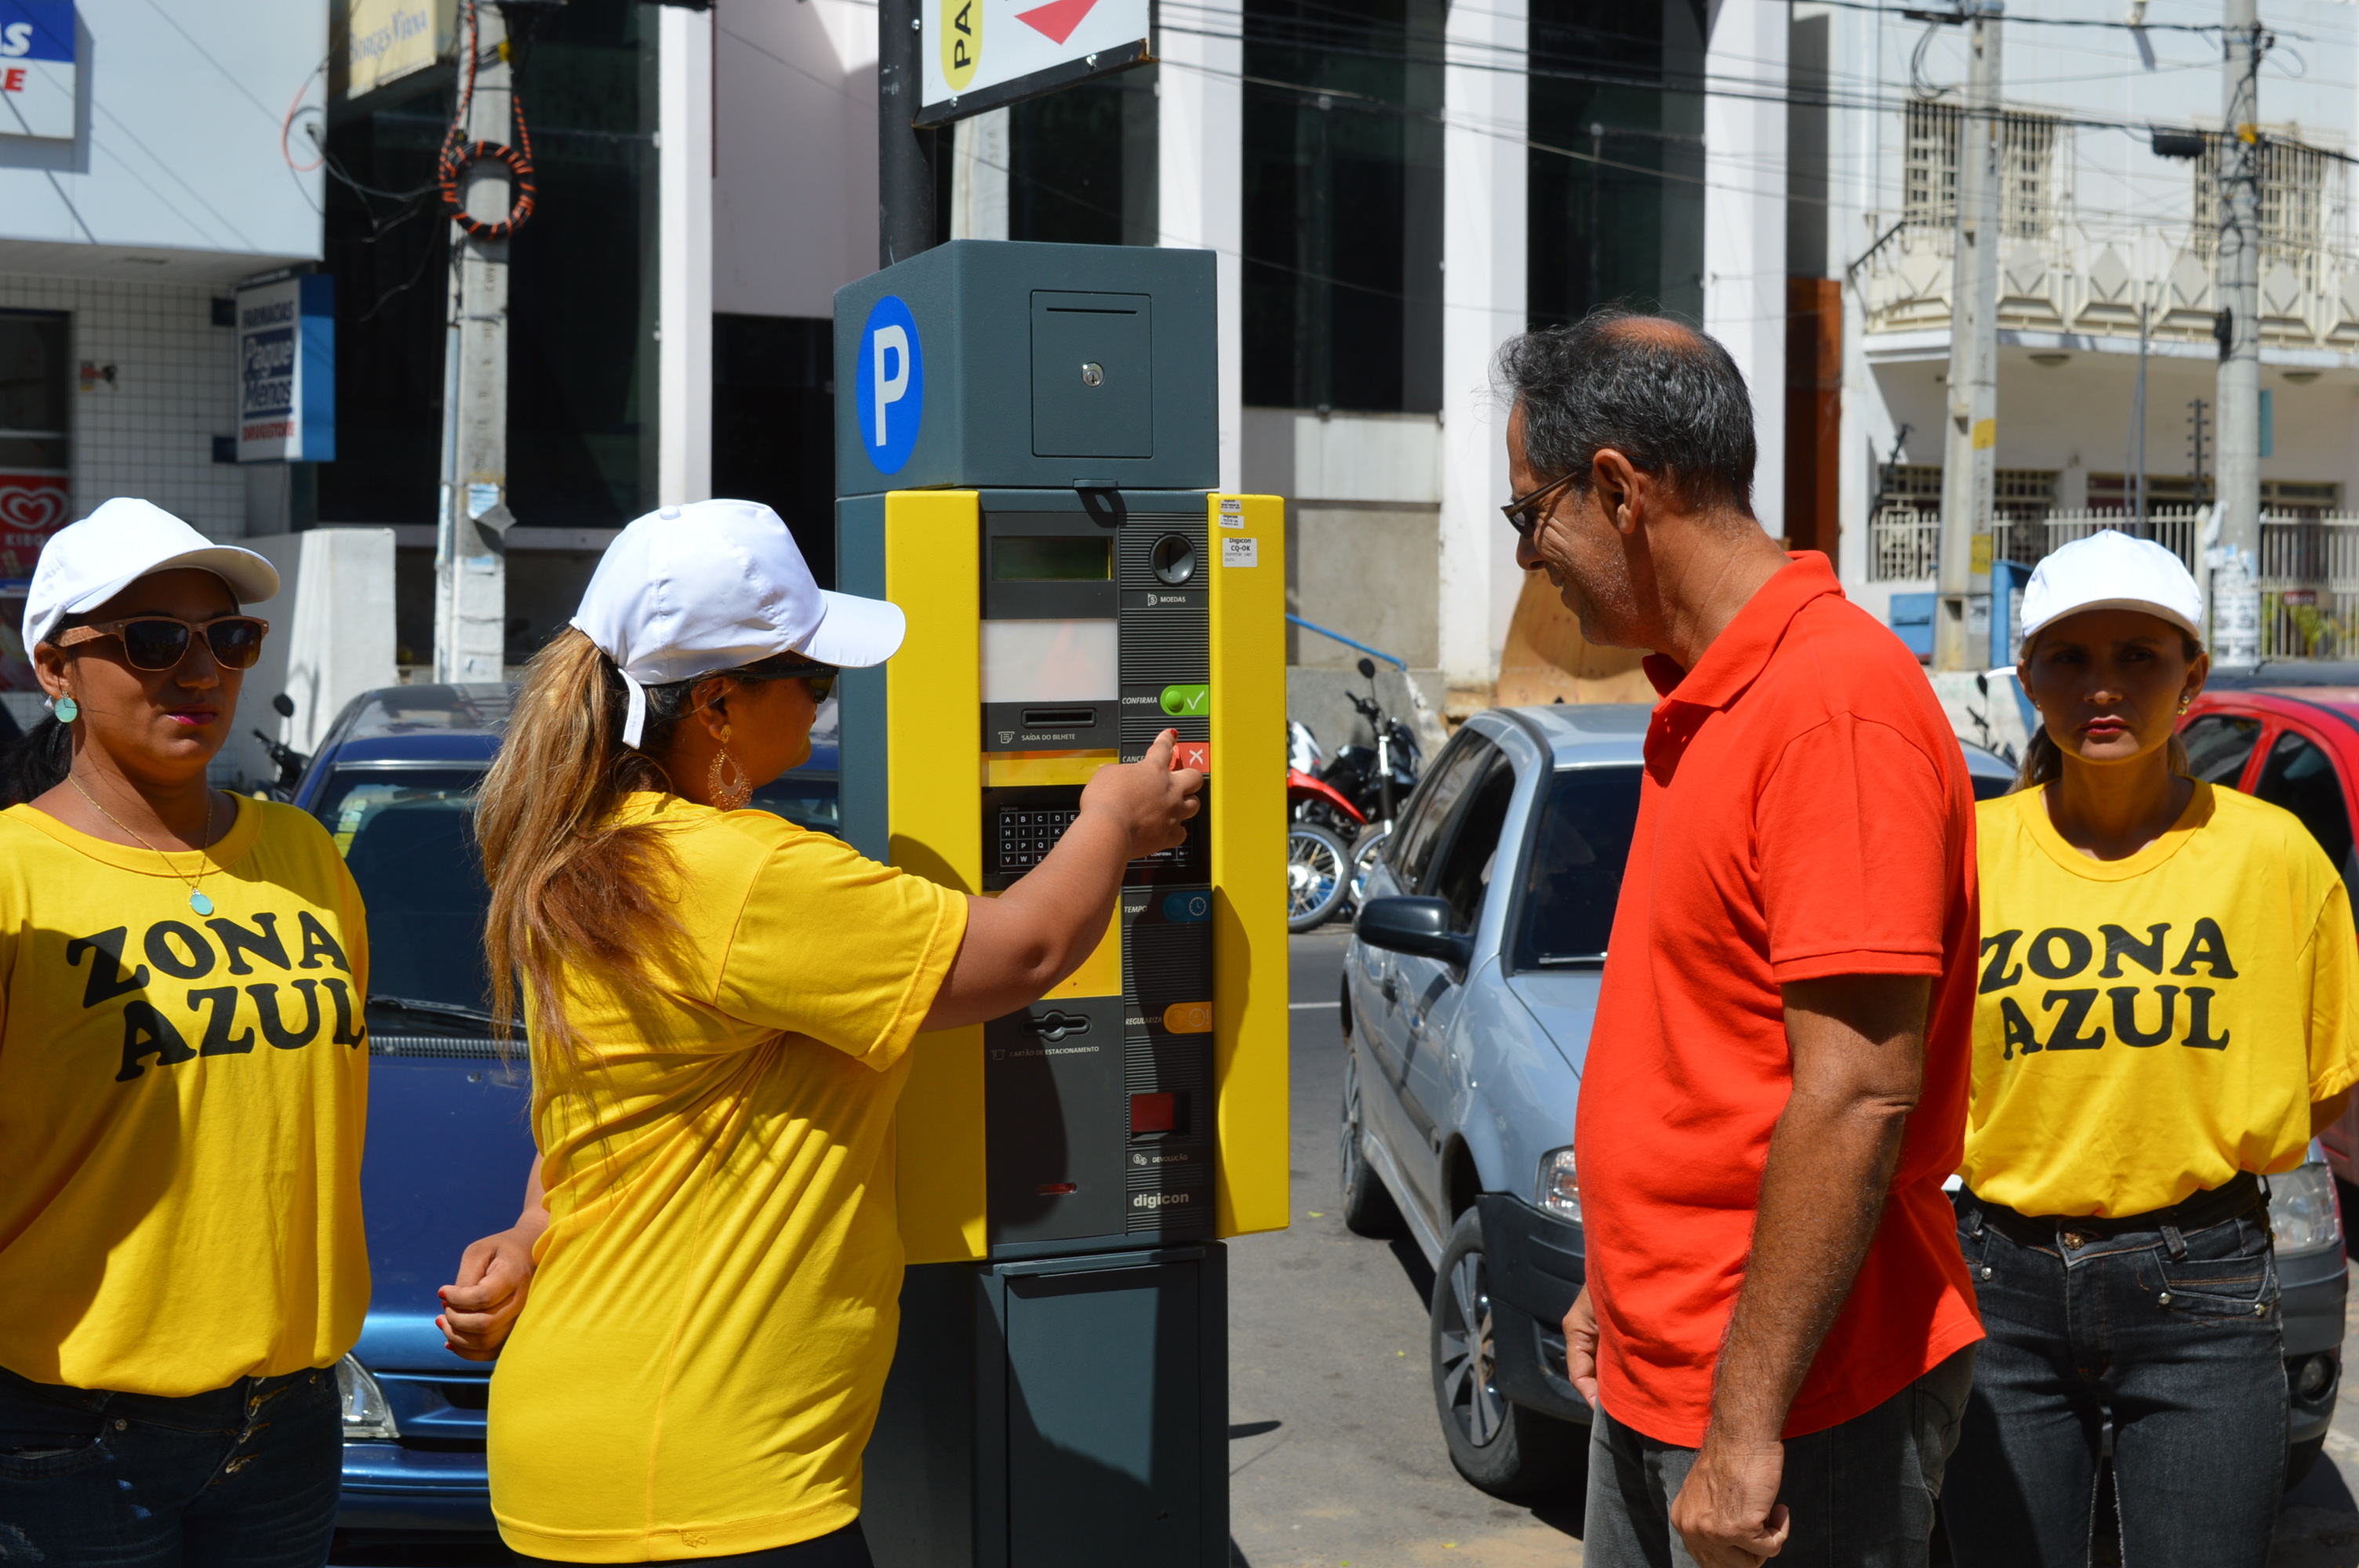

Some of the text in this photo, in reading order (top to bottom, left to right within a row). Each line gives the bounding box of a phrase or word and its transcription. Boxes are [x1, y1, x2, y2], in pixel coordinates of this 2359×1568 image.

[0, 21, 33, 57] S
[954, 0, 972, 70] PA
[0, 67, 27, 93] E
[244, 335, 293, 379] Pague
[244, 378, 293, 413] Menos
[874, 325, 910, 447] P
[5, 532, 48, 548] KIBO
[66, 910, 351, 1008] ZONA
[1979, 916, 2238, 995] ZONA
[115, 978, 365, 1082] AZUL
[2001, 985, 2230, 1061] AZUL
[1045, 1046, 1100, 1055] ESTACIONAMENTO
[1152, 1153, 1188, 1163] DEVOLUÇÃO
[1133, 1192, 1189, 1208] digicon
